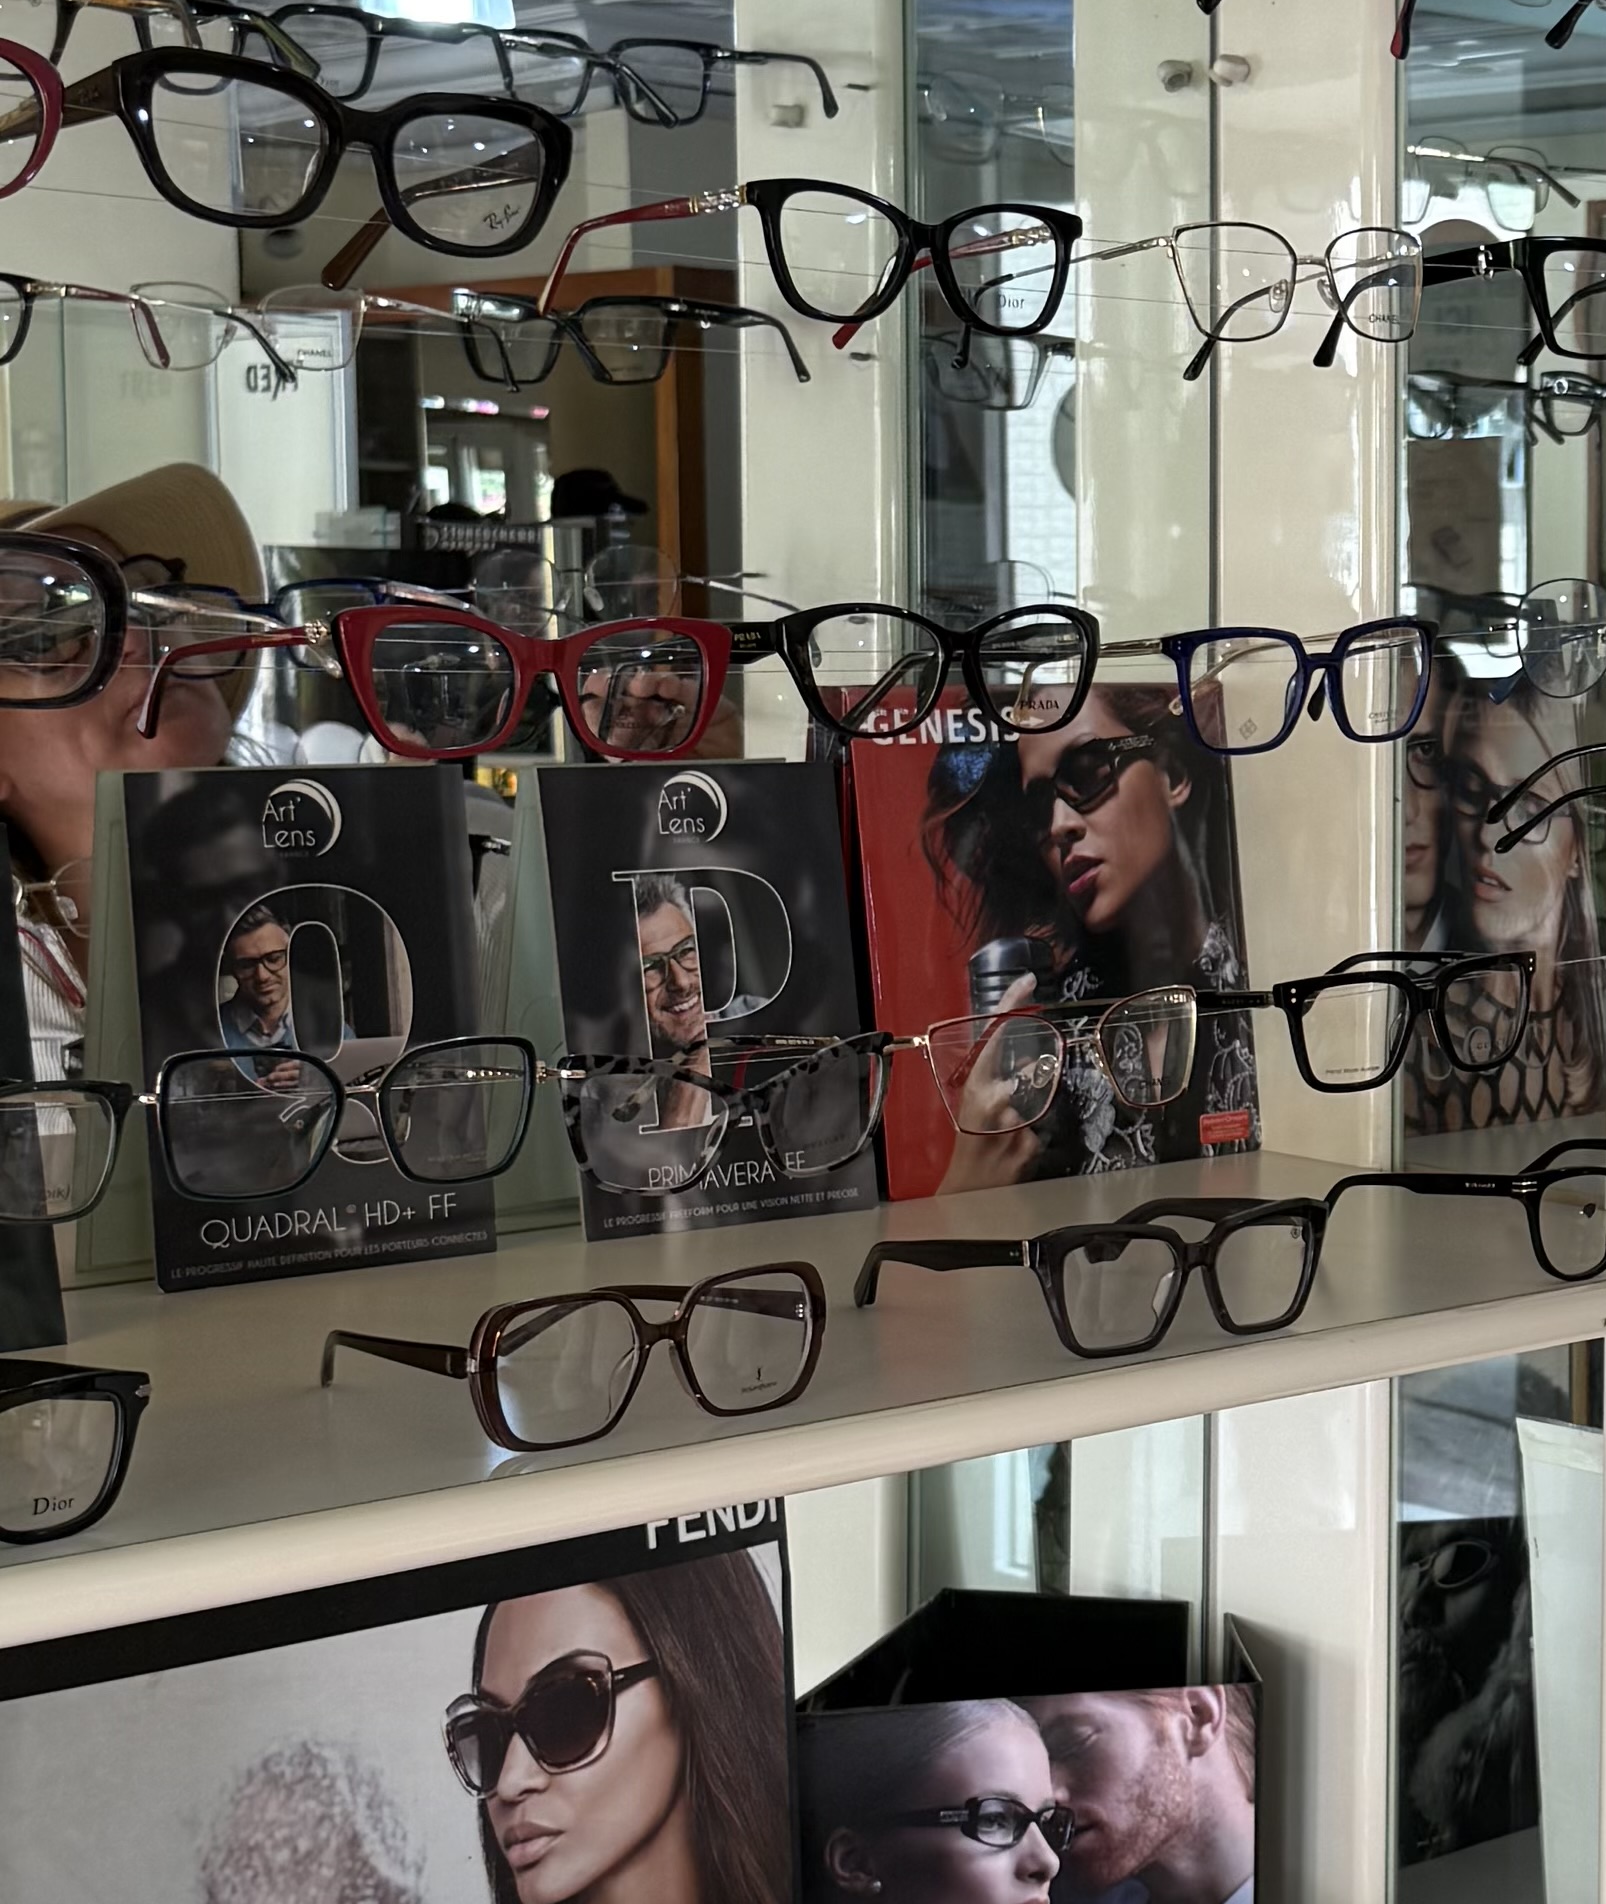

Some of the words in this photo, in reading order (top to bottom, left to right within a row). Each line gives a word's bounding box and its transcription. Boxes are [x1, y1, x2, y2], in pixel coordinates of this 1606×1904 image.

[1020, 699, 1060, 710] PRADA
[867, 708, 1020, 746] GENESIS
[264, 823, 316, 848] Lens
[658, 812, 706, 835] Lens
[648, 1159, 776, 1191] PRIMAVERA
[365, 1200, 416, 1228] HD+
[429, 1192, 457, 1220] FF
[33, 1497, 75, 1516] Dior
